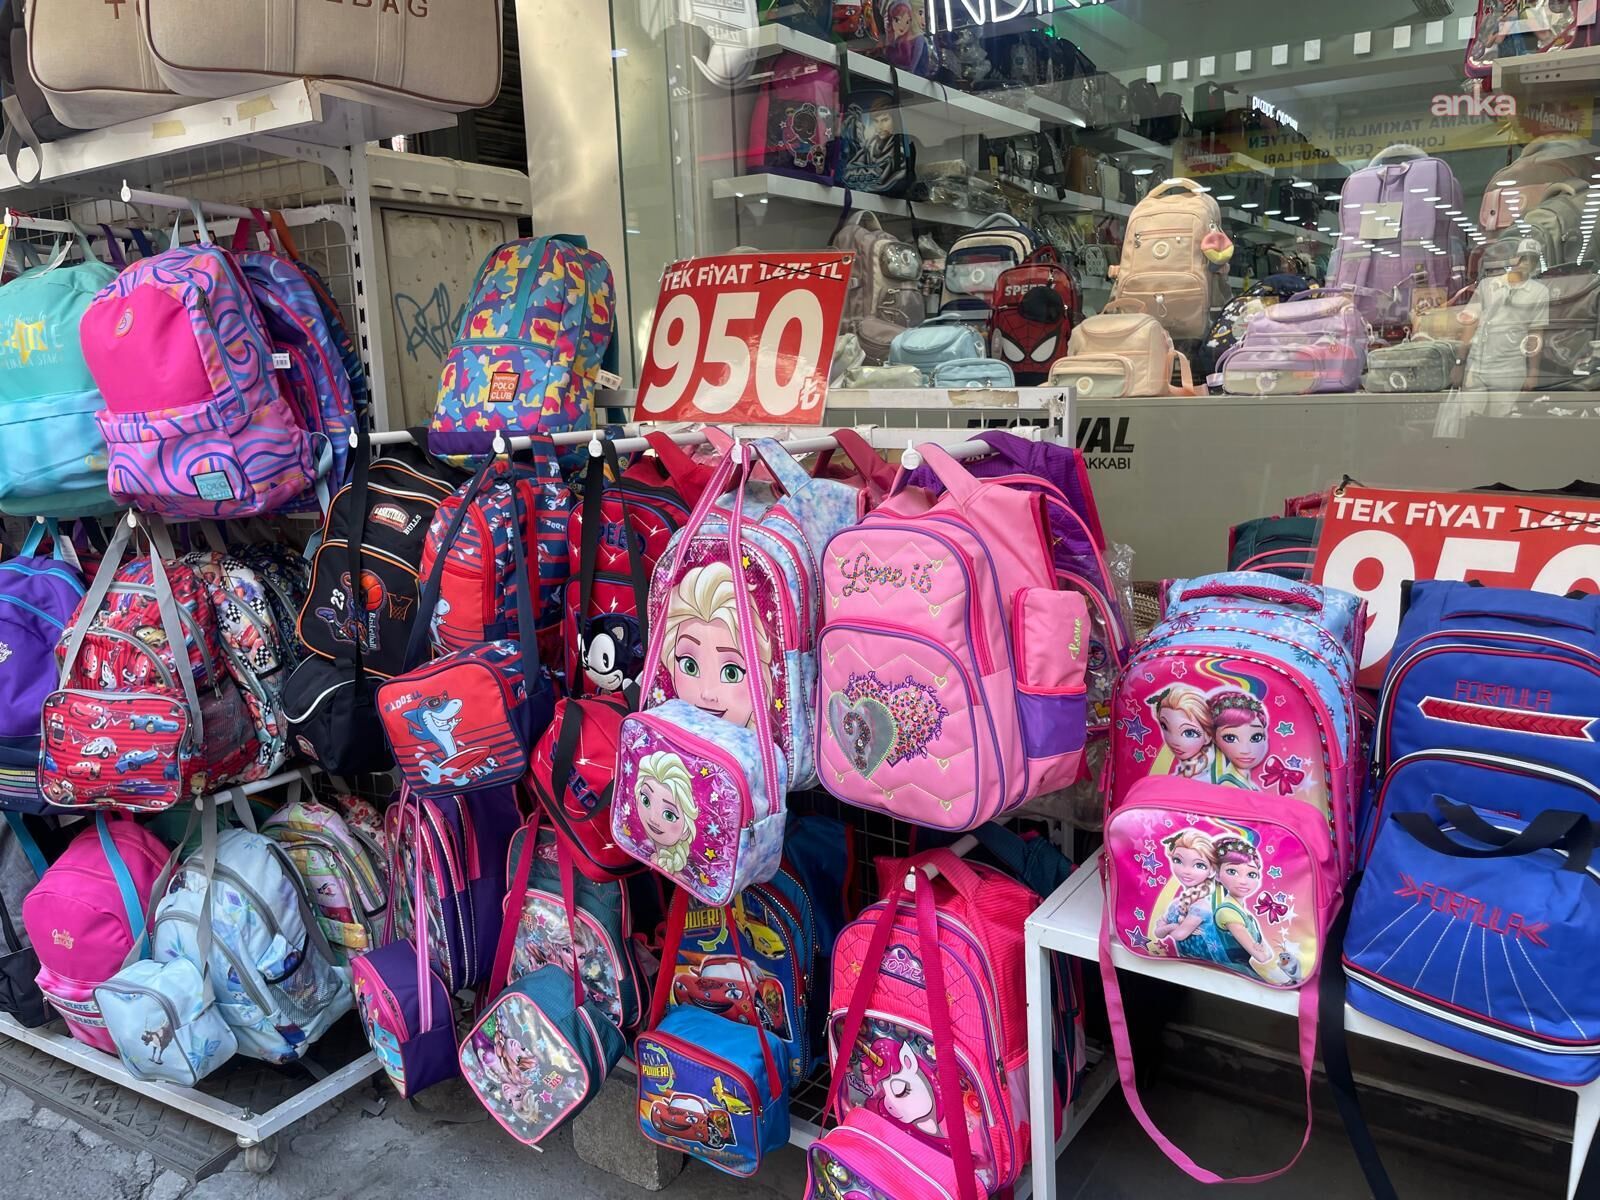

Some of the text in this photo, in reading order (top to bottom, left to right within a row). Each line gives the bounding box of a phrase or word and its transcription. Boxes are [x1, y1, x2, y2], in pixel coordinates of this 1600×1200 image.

[664, 262, 843, 292] TEK FİYAT 1.475 TL
[491, 391, 513, 400] CLUB
[493, 382, 515, 391] POLO
[1085, 457, 1131, 470] KKABI
[402, 514, 422, 536] BULLS
[1334, 497, 1399, 524] TEK
[1405, 500, 1505, 531] FİYAT
[841, 551, 934, 597] Love is
[330, 588, 346, 611] 23
[368, 612, 378, 650] Basketball
[1455, 679, 1552, 712] FORMULA
[1417, 881, 1524, 939] FORMULA
